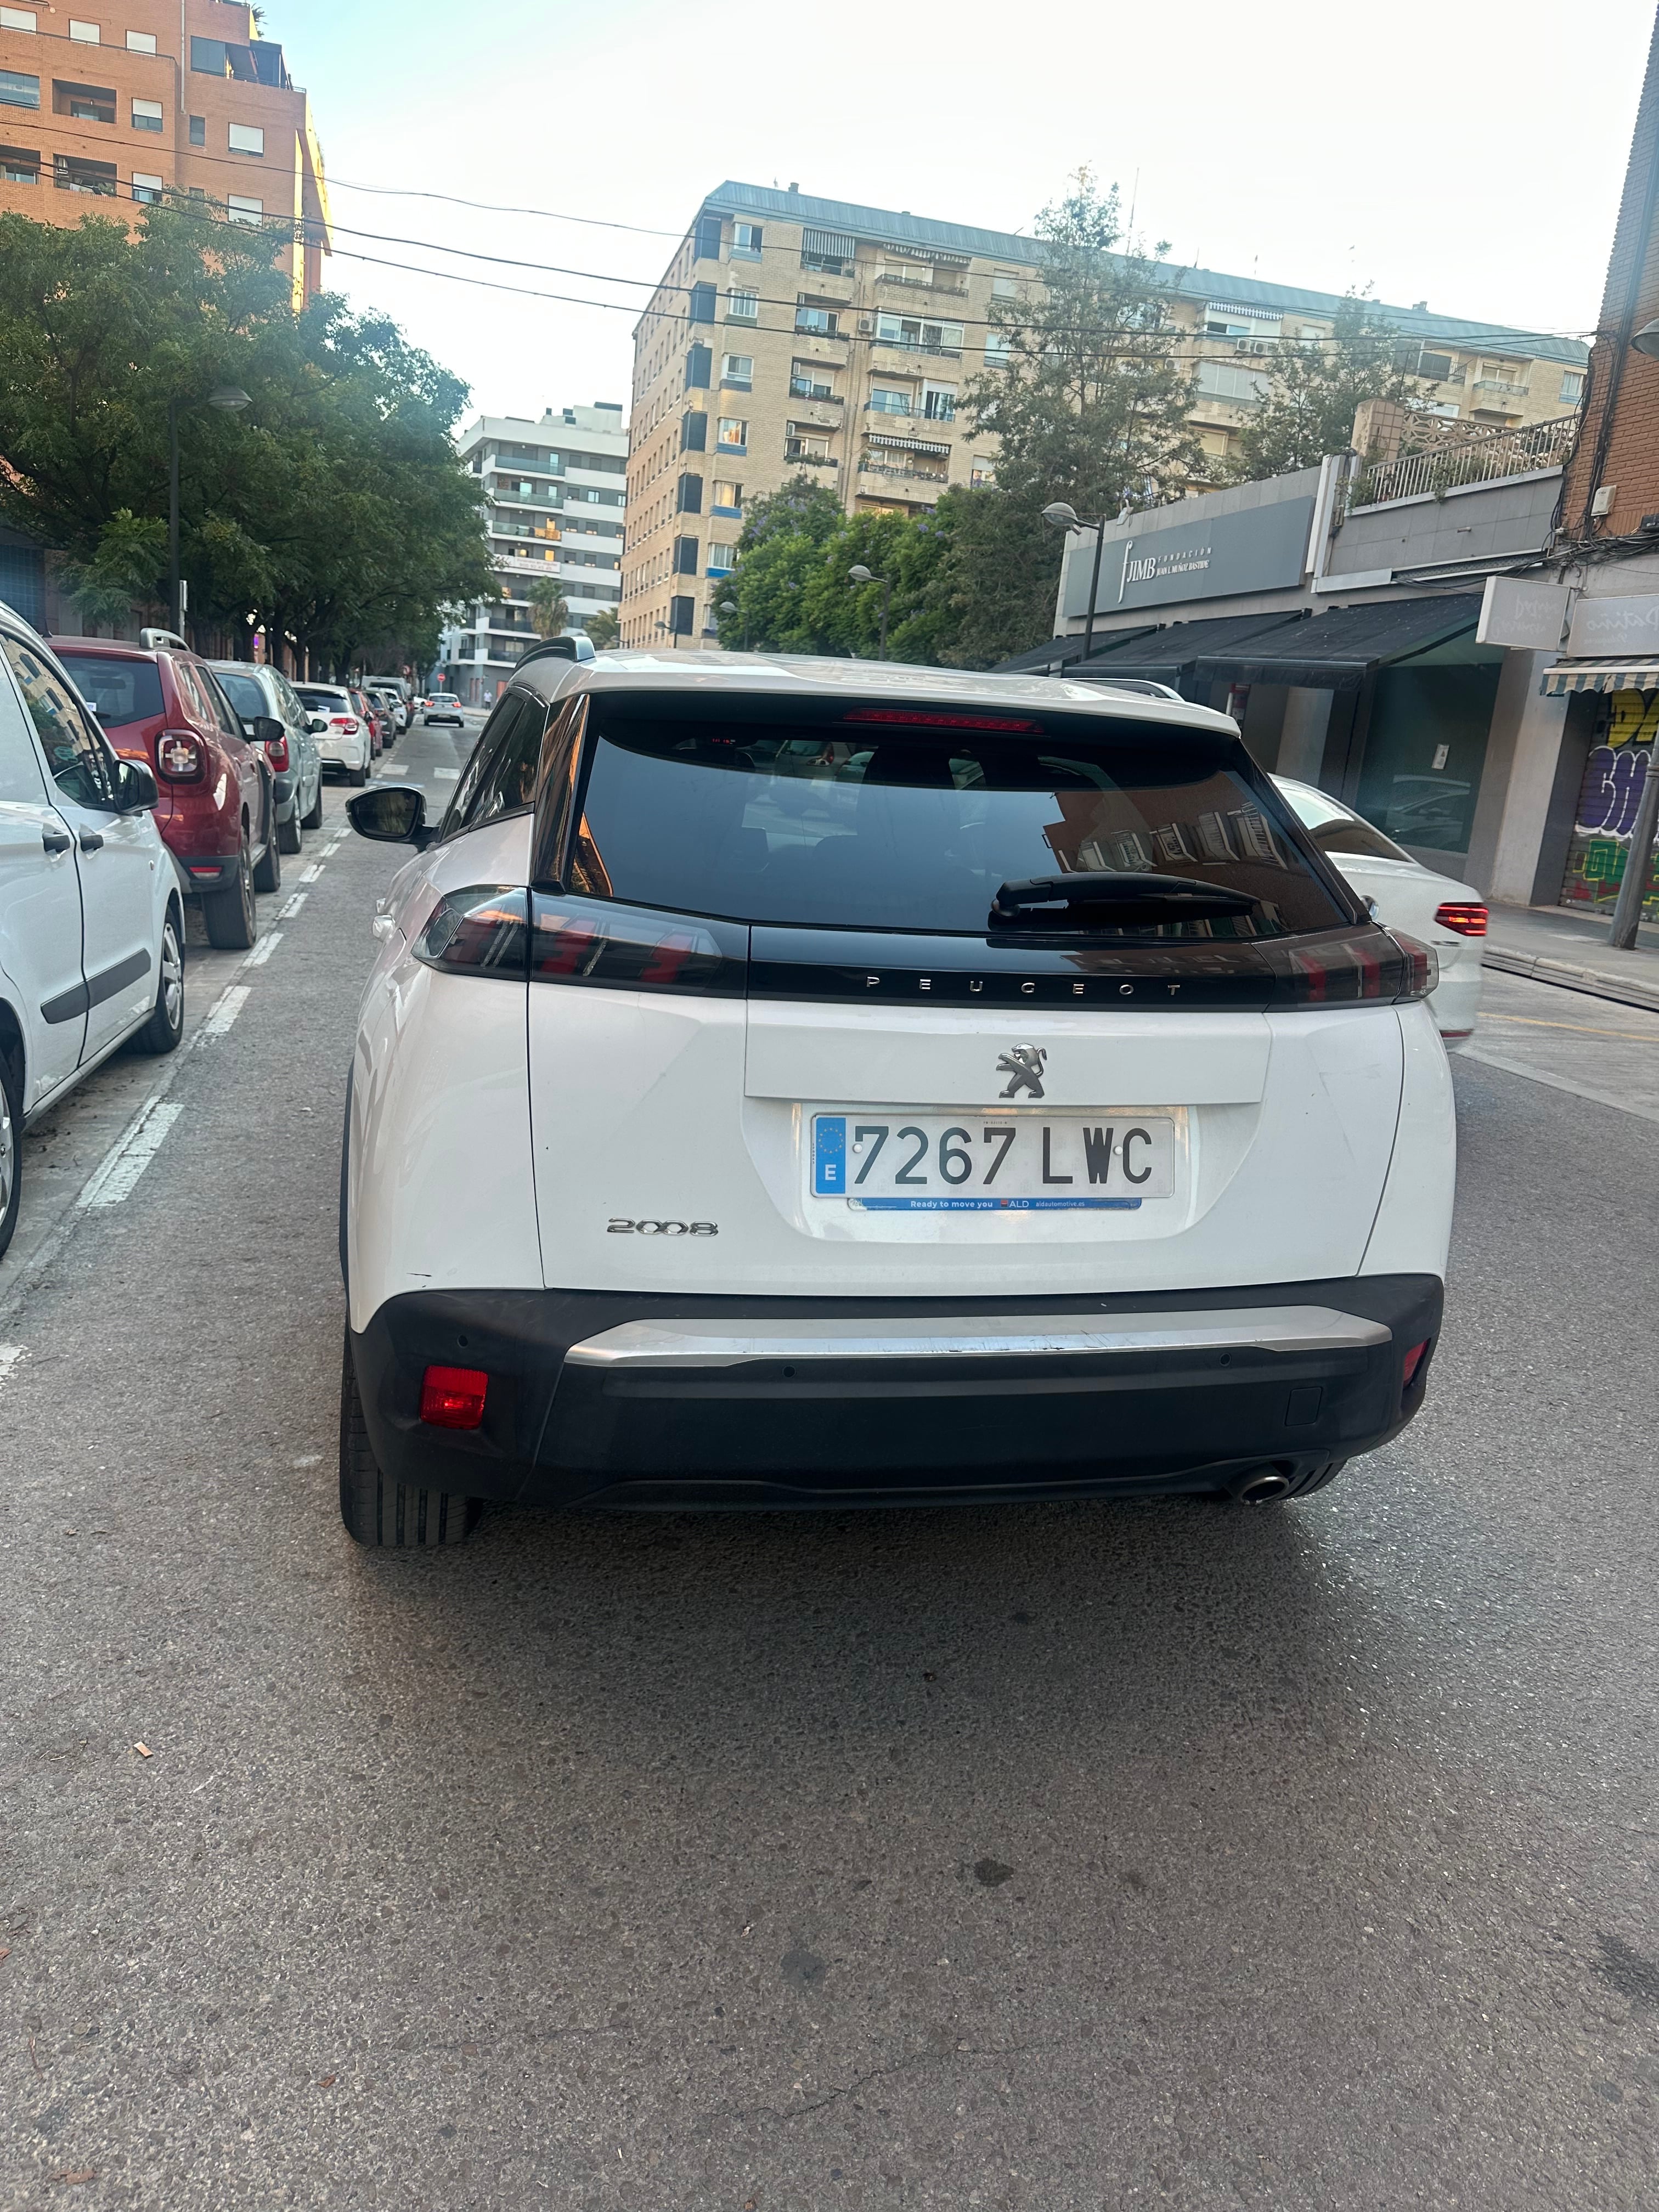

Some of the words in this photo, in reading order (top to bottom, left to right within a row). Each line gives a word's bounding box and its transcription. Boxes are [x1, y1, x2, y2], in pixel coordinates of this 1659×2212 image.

[1158, 546, 1212, 563] FUNDACIÓN
[1156, 567, 1167, 578] JUAN
[1171, 562, 1189, 573] MUÑOZ
[1189, 560, 1210, 571] BASTIDE
[866, 976, 1180, 996] PEUGEOT
[854, 1126, 1015, 1184] 7267
[1043, 1127, 1152, 1184] LWC
[825, 1164, 837, 1181] E
[910, 1200, 936, 1209] Ready
[607, 1217, 719, 1237] 2008
